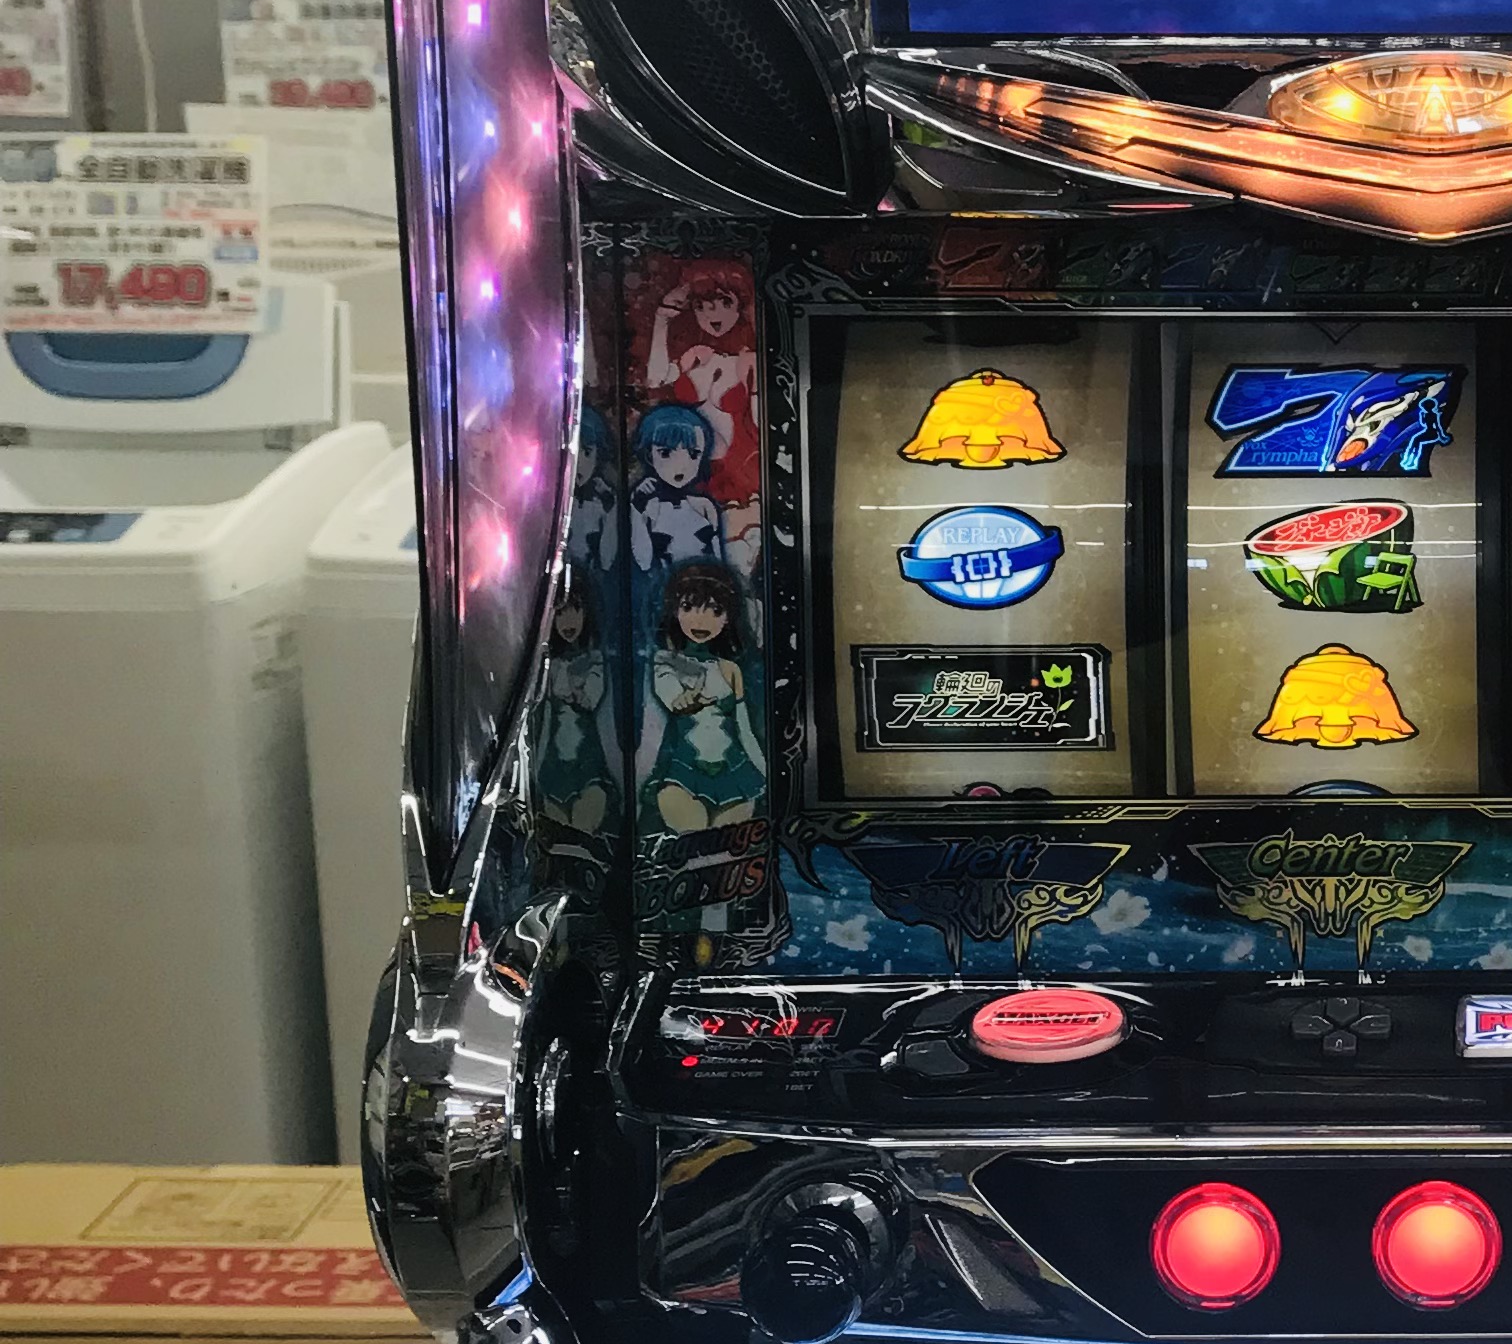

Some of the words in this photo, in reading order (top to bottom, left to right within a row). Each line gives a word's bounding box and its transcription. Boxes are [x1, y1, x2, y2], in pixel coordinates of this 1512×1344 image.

[56, 260, 212, 313] 17,490
[943, 526, 1021, 545] REPLAY
[1249, 834, 1412, 879] Center
